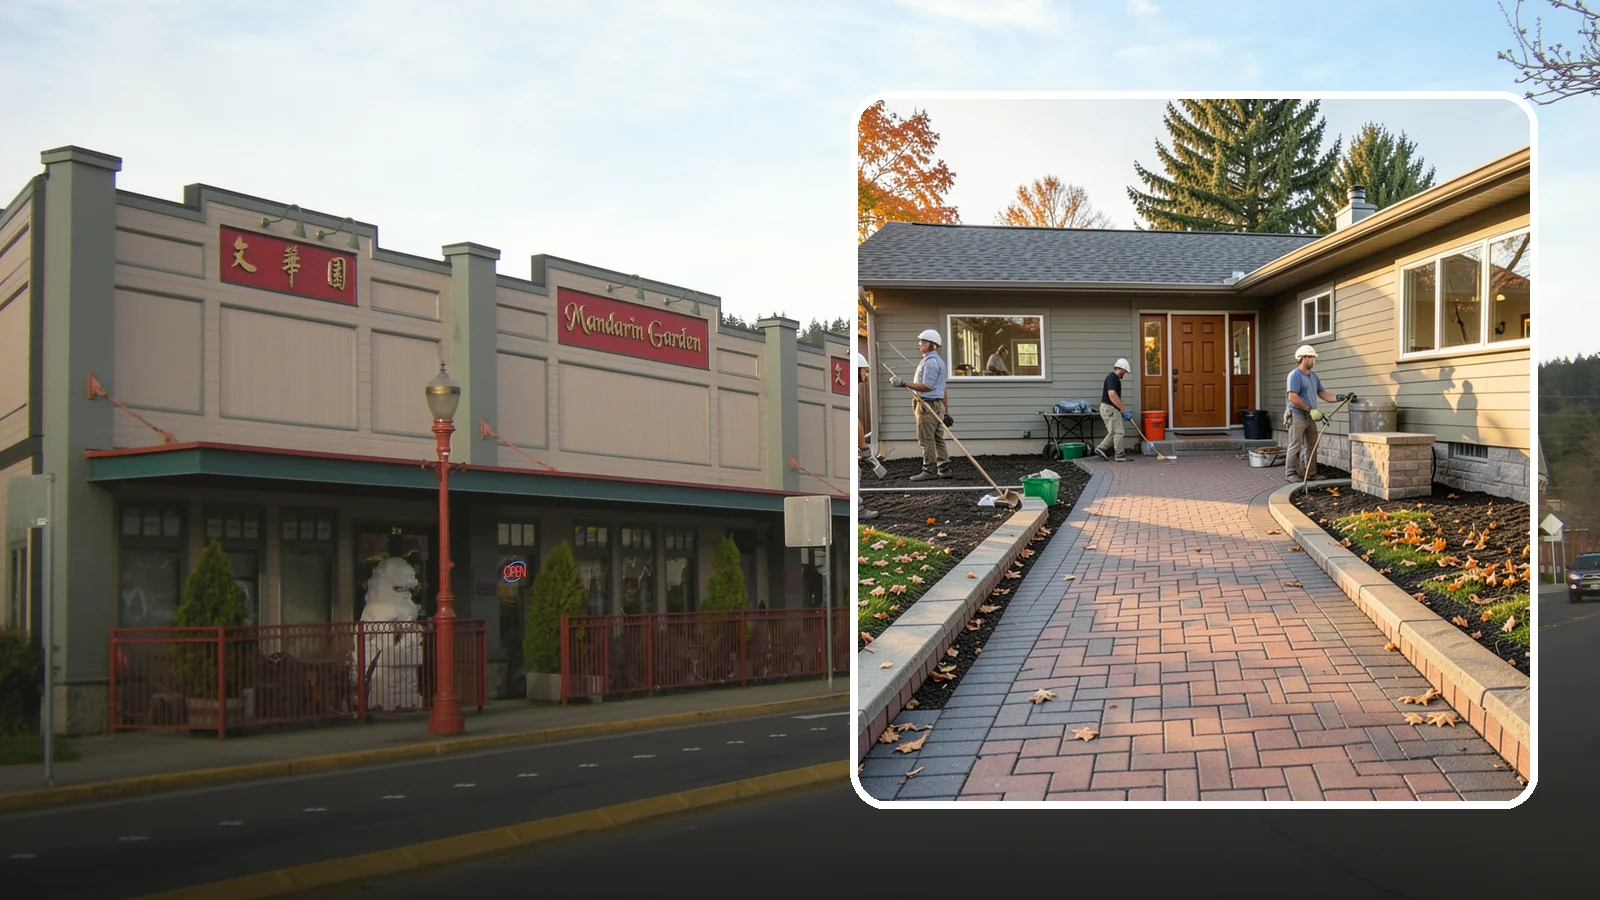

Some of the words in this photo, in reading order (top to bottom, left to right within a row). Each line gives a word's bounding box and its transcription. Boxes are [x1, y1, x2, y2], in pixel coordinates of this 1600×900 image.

[230, 235, 346, 290] 文華園
[564, 302, 644, 341] Mandarin
[647, 320, 702, 352] Garden
[503, 565, 527, 578] OPEN
